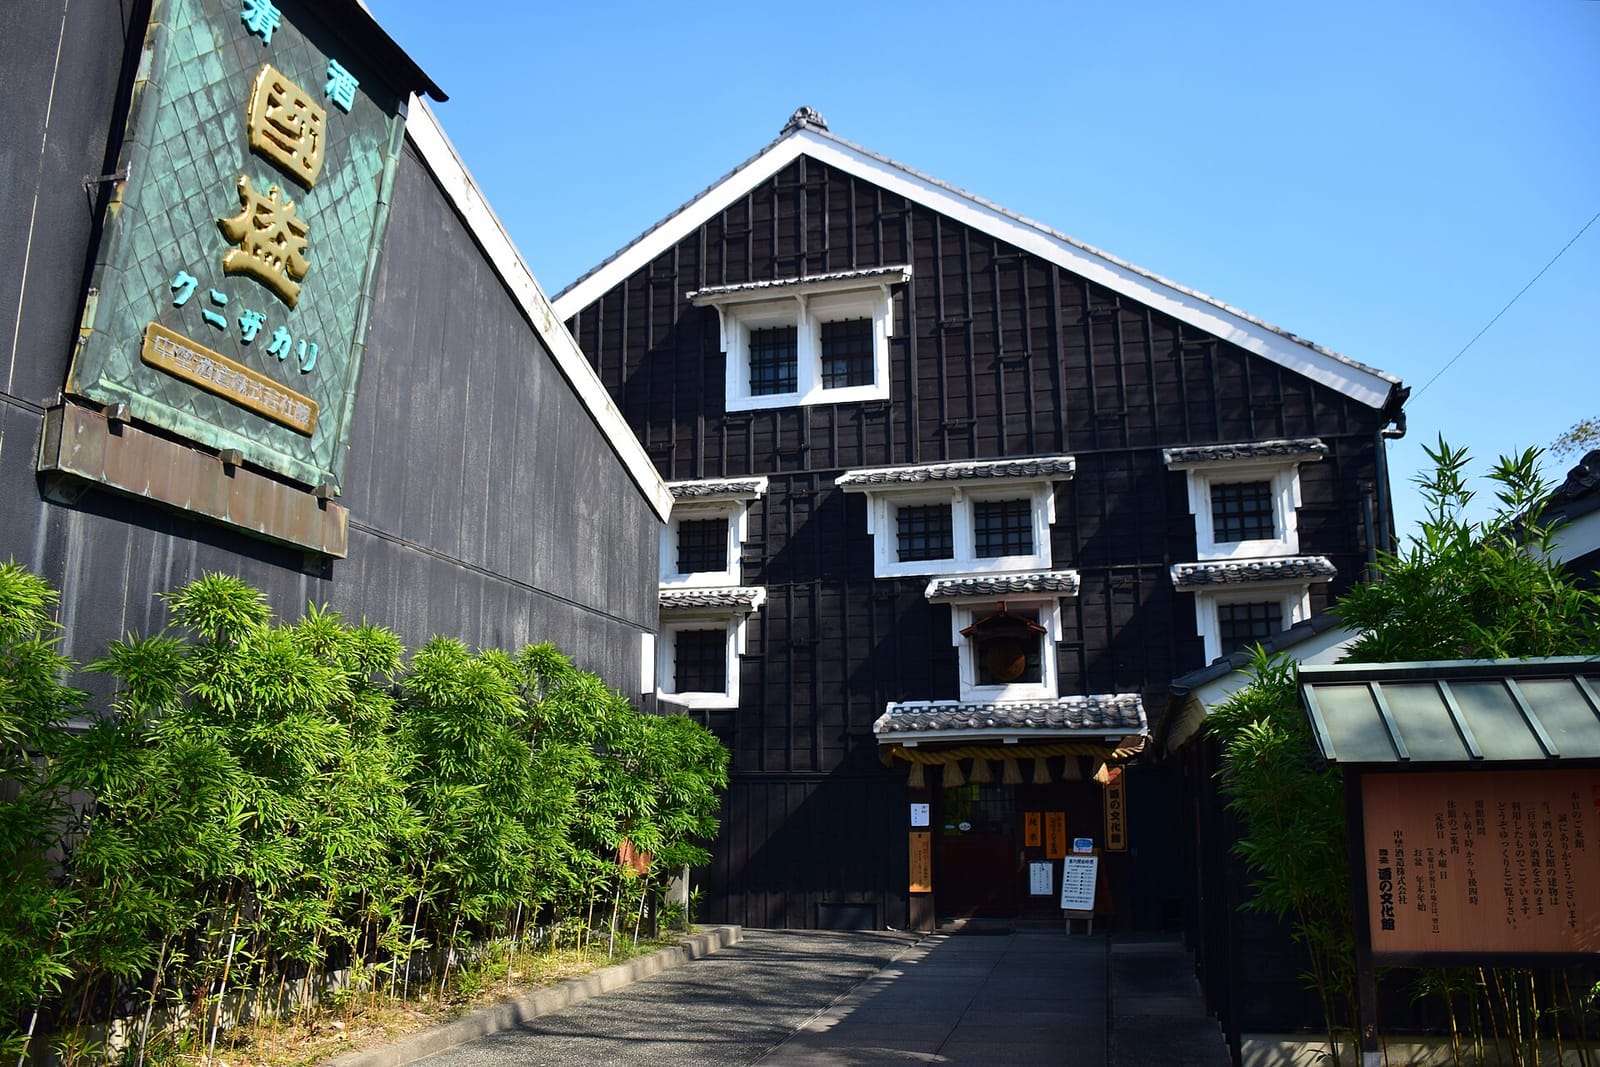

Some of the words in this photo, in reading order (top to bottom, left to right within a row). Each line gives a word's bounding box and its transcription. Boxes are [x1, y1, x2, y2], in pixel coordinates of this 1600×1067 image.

[241, 0, 360, 112] 清酒
[172, 271, 319, 373] クニザカリ
[1378, 867, 1395, 931] 酒の文化館
